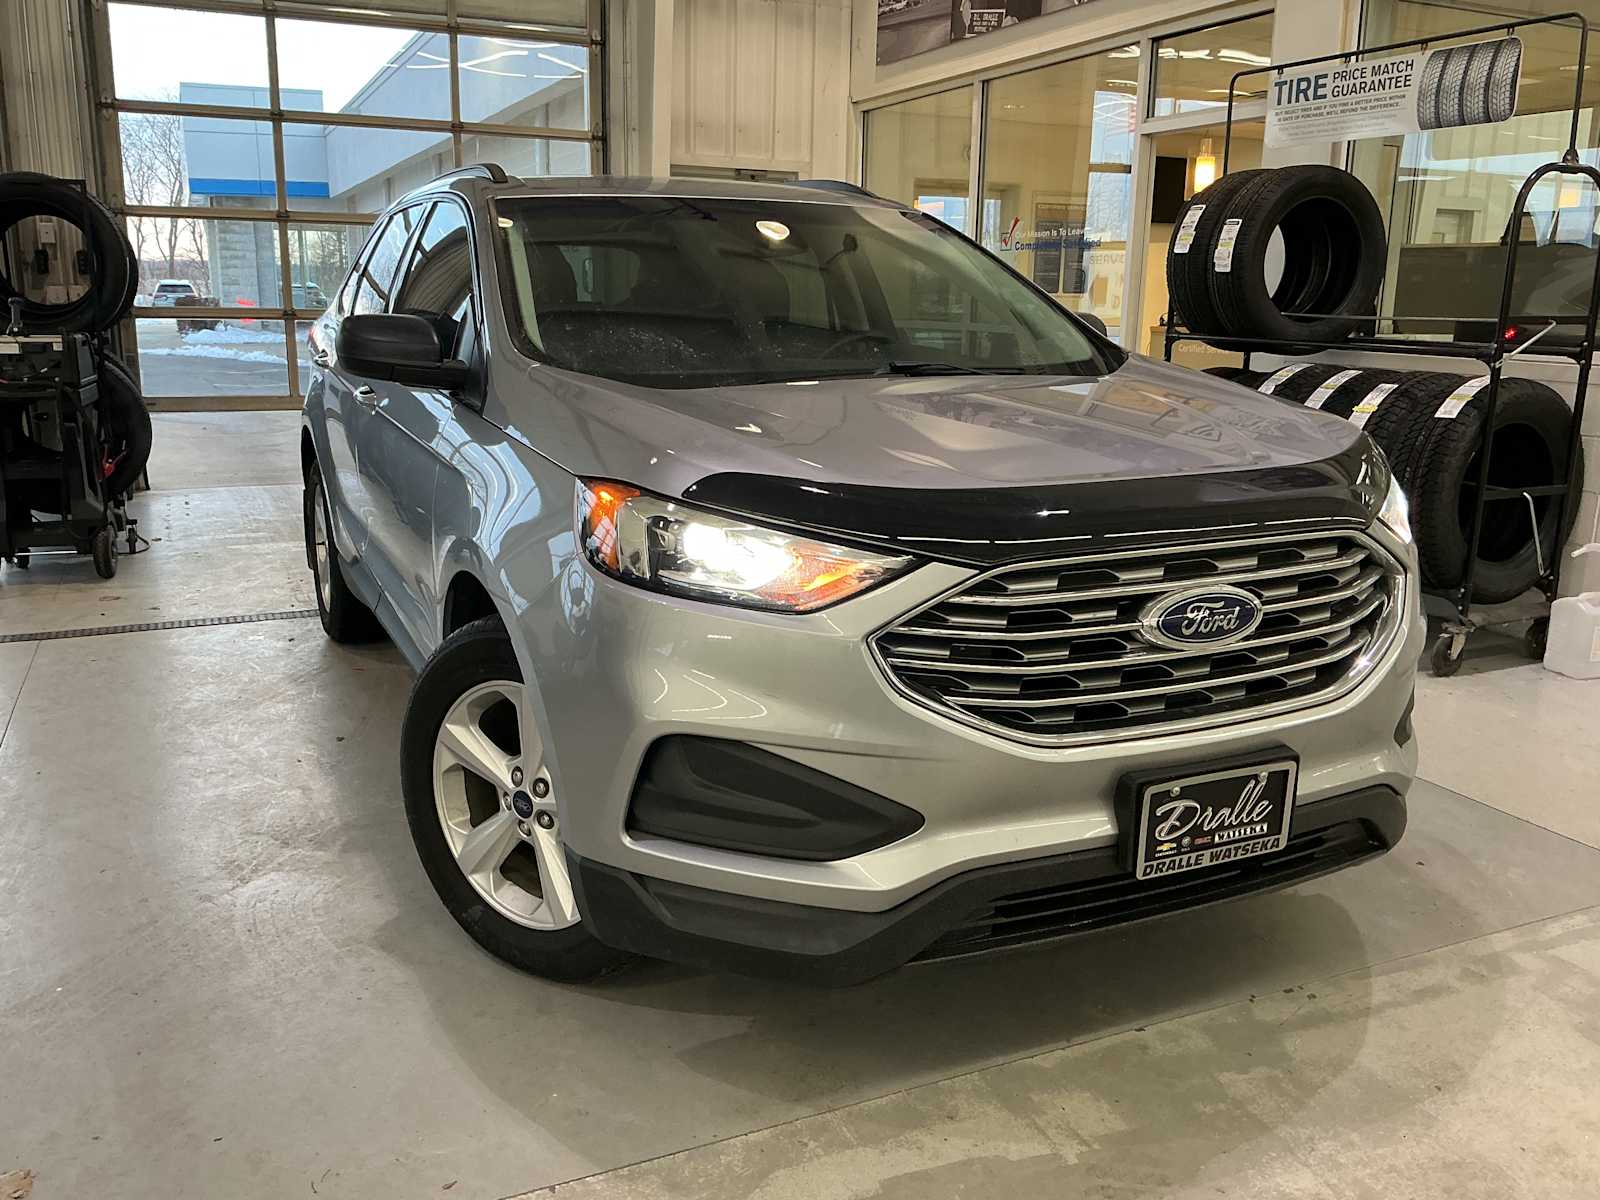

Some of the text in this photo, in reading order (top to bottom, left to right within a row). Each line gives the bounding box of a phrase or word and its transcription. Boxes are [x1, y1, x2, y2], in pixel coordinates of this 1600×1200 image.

[1331, 75, 1412, 98] GUARANTEE
[1333, 59, 1414, 84] PRICE MATCH
[1274, 73, 1328, 106] TIRE
[1181, 600, 1240, 636] Ford
[1155, 778, 1273, 841] Dralle
[1216, 824, 1266, 842] WATSEKA
[1142, 837, 1281, 878] DRALLE WATSEKA
